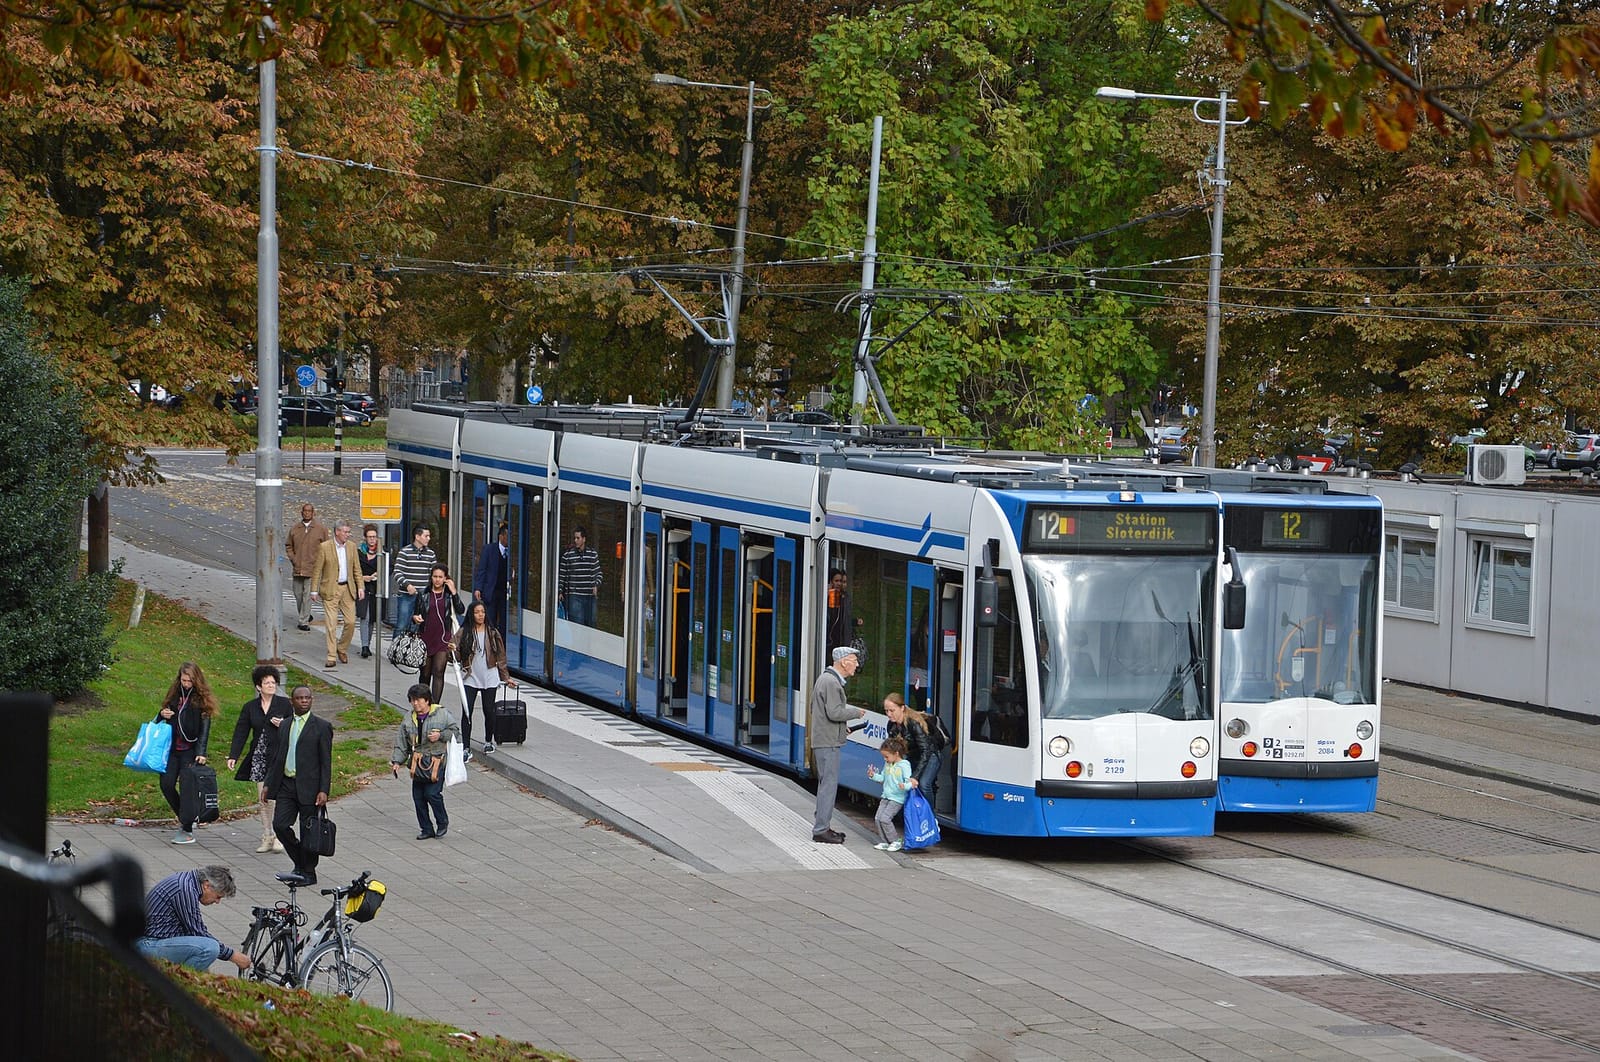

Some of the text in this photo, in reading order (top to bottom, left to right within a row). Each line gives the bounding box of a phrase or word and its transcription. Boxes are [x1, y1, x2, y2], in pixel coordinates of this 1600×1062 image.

[1038, 511, 1060, 539] 12
[1115, 512, 1166, 526] Station
[1280, 511, 1301, 538] 12
[1106, 526, 1175, 541] Sloterdijk
[873, 724, 887, 740] GVB
[1104, 766, 1125, 774] 2129
